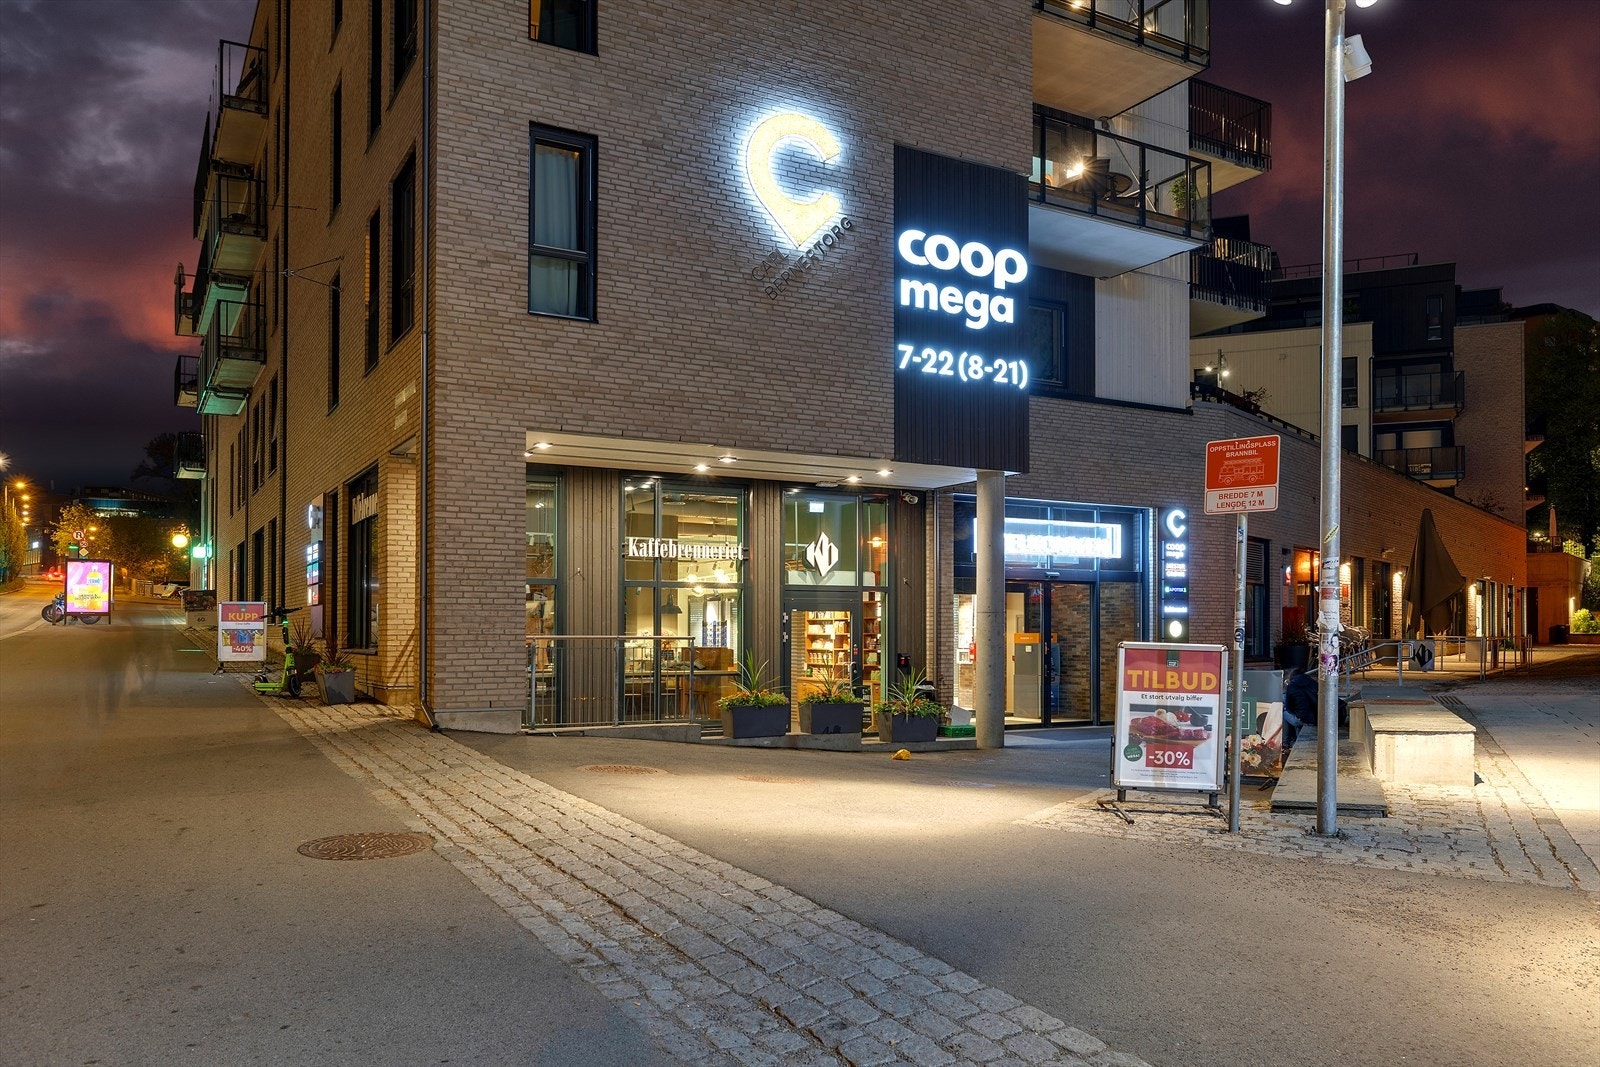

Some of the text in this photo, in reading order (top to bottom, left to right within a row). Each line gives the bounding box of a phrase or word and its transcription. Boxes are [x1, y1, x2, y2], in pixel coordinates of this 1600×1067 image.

[752, 249, 789, 281] CARL
[898, 229, 1028, 289] coop
[900, 279, 1014, 330] mega
[898, 345, 1028, 389] 7-22 (8-21)
[1209, 440, 1276, 452] OPPSTILLINGSPLASS
[1225, 449, 1258, 457] BRANNBIL
[1218, 492, 1249, 500] BREDDE
[1216, 501, 1246, 509] LENGDE
[628, 537, 744, 560] Kaffebrenneriet
[228, 612, 259, 621] KUPP
[1127, 669, 1217, 691] TILBUD
[1165, 694, 1184, 702] utvalg
[1148, 750, 1191, 766] -30%
